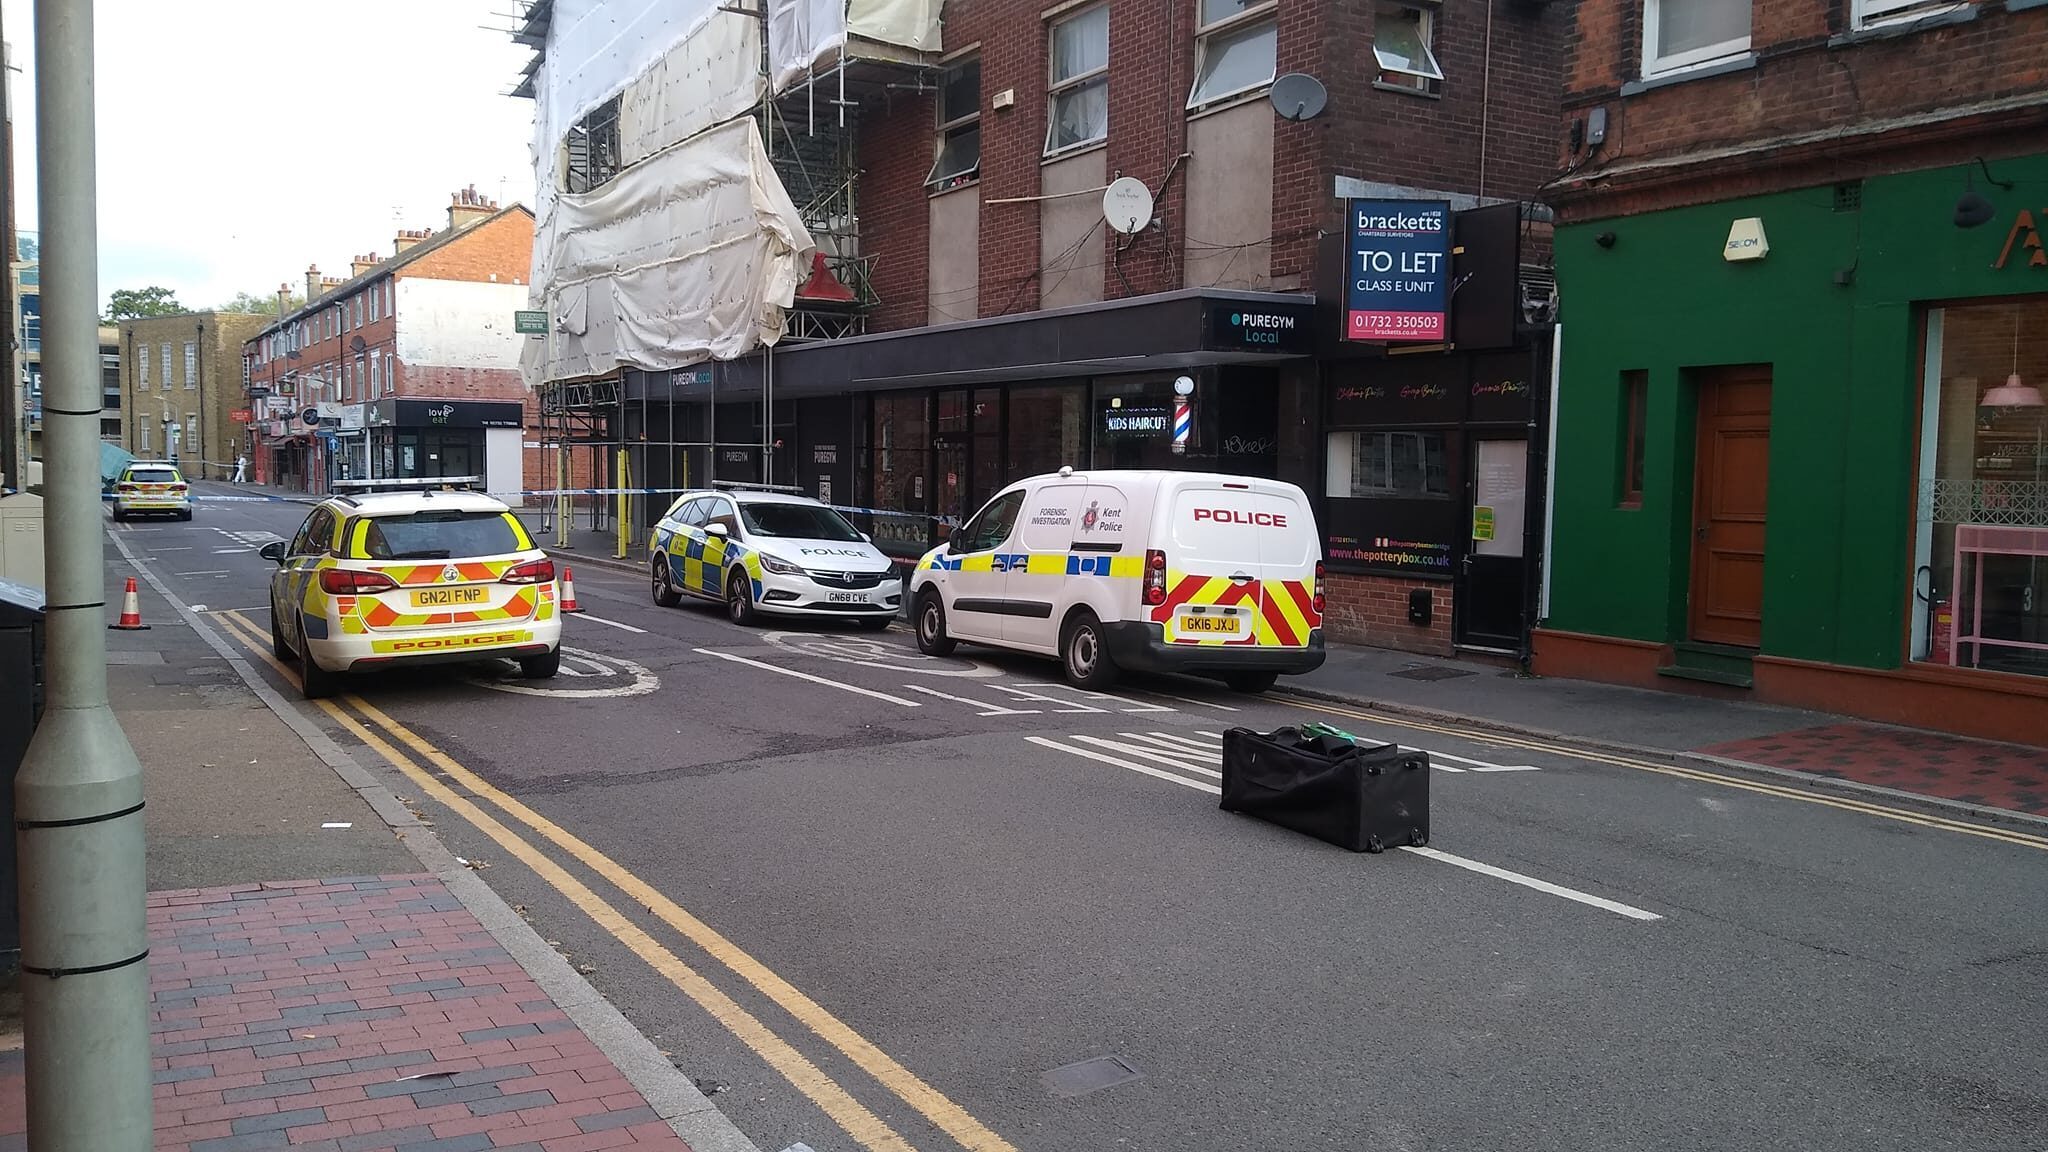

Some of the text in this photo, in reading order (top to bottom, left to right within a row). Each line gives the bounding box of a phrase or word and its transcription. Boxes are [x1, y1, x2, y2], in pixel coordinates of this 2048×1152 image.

[1358, 211, 1441, 230] bracketts
[1995, 207, 2048, 268] A
[1728, 239, 1758, 250] SECOM
[1358, 251, 1442, 273] TO LET
[1357, 280, 1434, 293] CLASS E UNIT
[1242, 313, 1294, 329] PUREGYM
[1355, 315, 1438, 328] 01732 350503
[1246, 329, 1279, 343] Local
[1375, 328, 1418, 336] bracketts.co.uk
[428, 405, 454, 417] love
[432, 416, 448, 424] eat
[1108, 416, 1167, 430] KIDS HAIRCUT
[1039, 508, 1067, 517] FORENSIC
[1102, 507, 1121, 518] Kent
[1193, 508, 1287, 528] POLICE
[1031, 516, 1071, 526] INVESTIGATION
[1099, 521, 1123, 532] Police
[800, 548, 870, 558] POLICE
[1329, 548, 1449, 566] www.thepotterybox.co.uk
[420, 589, 481, 604] GN21 FNP
[829, 592, 868, 603] GN68 CVE
[1187, 618, 1234, 631] GK16 JXJ
[393, 634, 515, 650] POLICE
